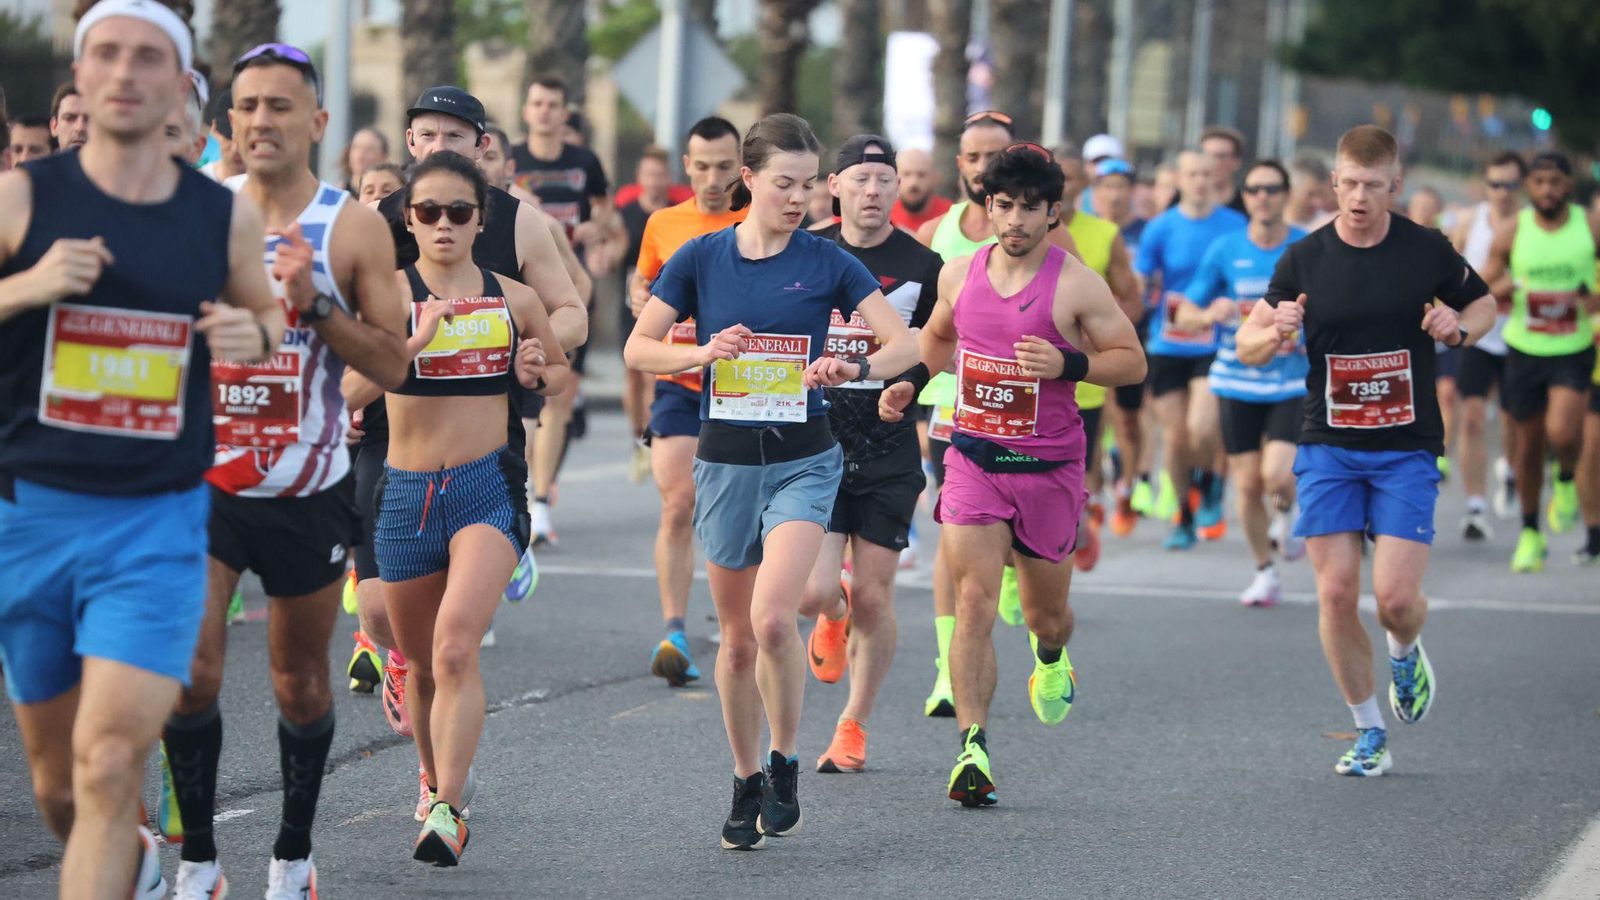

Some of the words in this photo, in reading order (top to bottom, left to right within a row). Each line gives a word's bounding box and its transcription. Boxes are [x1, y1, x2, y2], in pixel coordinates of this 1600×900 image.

[444, 319, 491, 337] 5890
[744, 338, 802, 353] ENERALI
[827, 338, 869, 354] 5549
[1347, 355, 1404, 370] GENERALI
[732, 364, 788, 382] 14559
[218, 384, 271, 405] 1892
[975, 384, 1014, 403] 5736
[1347, 380, 1391, 396] 7382
